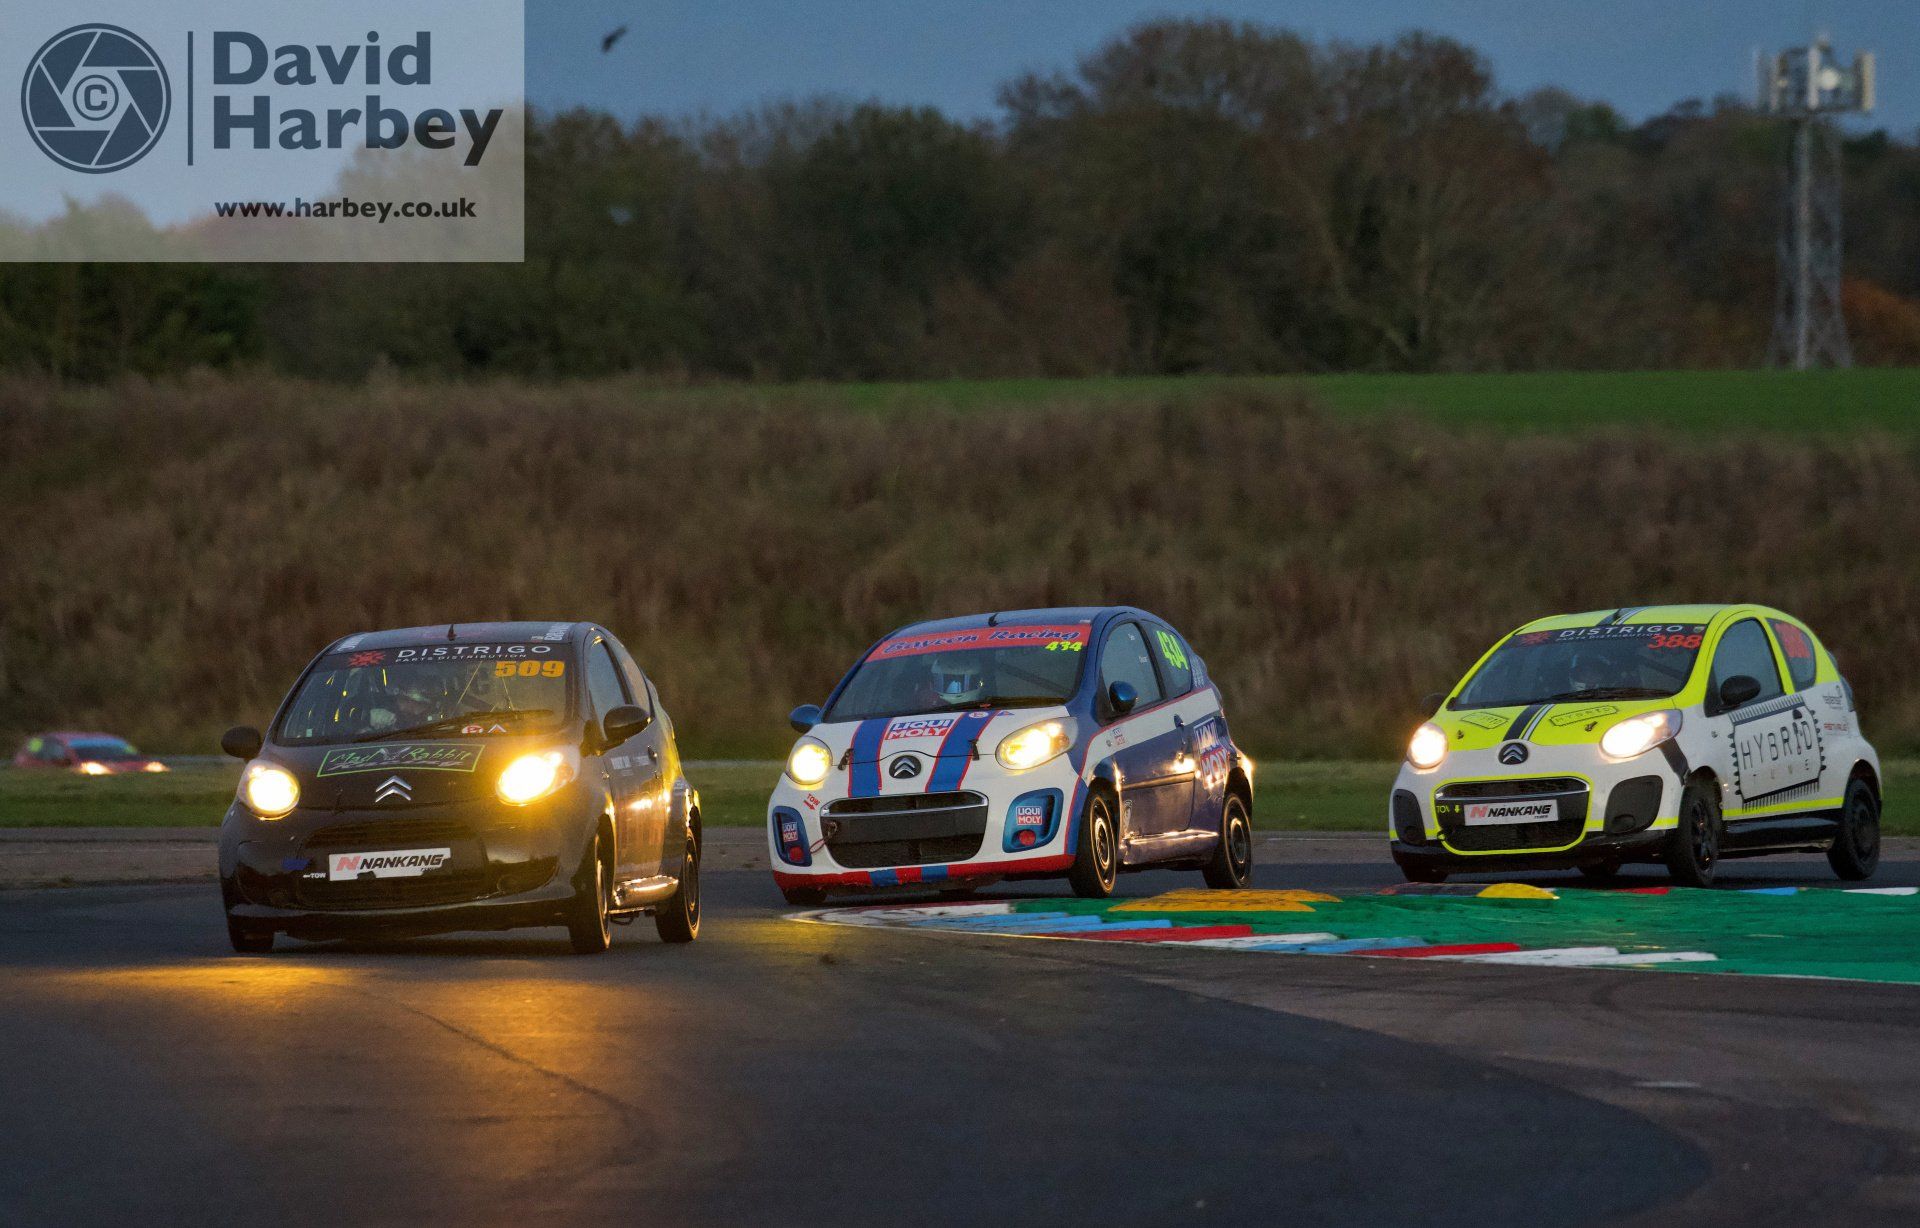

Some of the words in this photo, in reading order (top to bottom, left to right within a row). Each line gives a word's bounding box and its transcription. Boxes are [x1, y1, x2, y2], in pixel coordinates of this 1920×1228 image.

[989, 629, 1081, 641] Racing
[1559, 625, 1683, 638] DISTRIGO
[1044, 641, 1083, 652] 434
[1648, 634, 1702, 649] 388
[397, 645, 551, 658] DISTRIGO
[495, 660, 565, 678] 509
[890, 719, 951, 732] LIQUI
[886, 728, 949, 740] MOLY
[1018, 807, 1041, 816] LIQUI
[1488, 804, 1552, 818] NANKANG
[1018, 816, 1041, 824] MOLY
[360, 854, 444, 870] NANKANG
